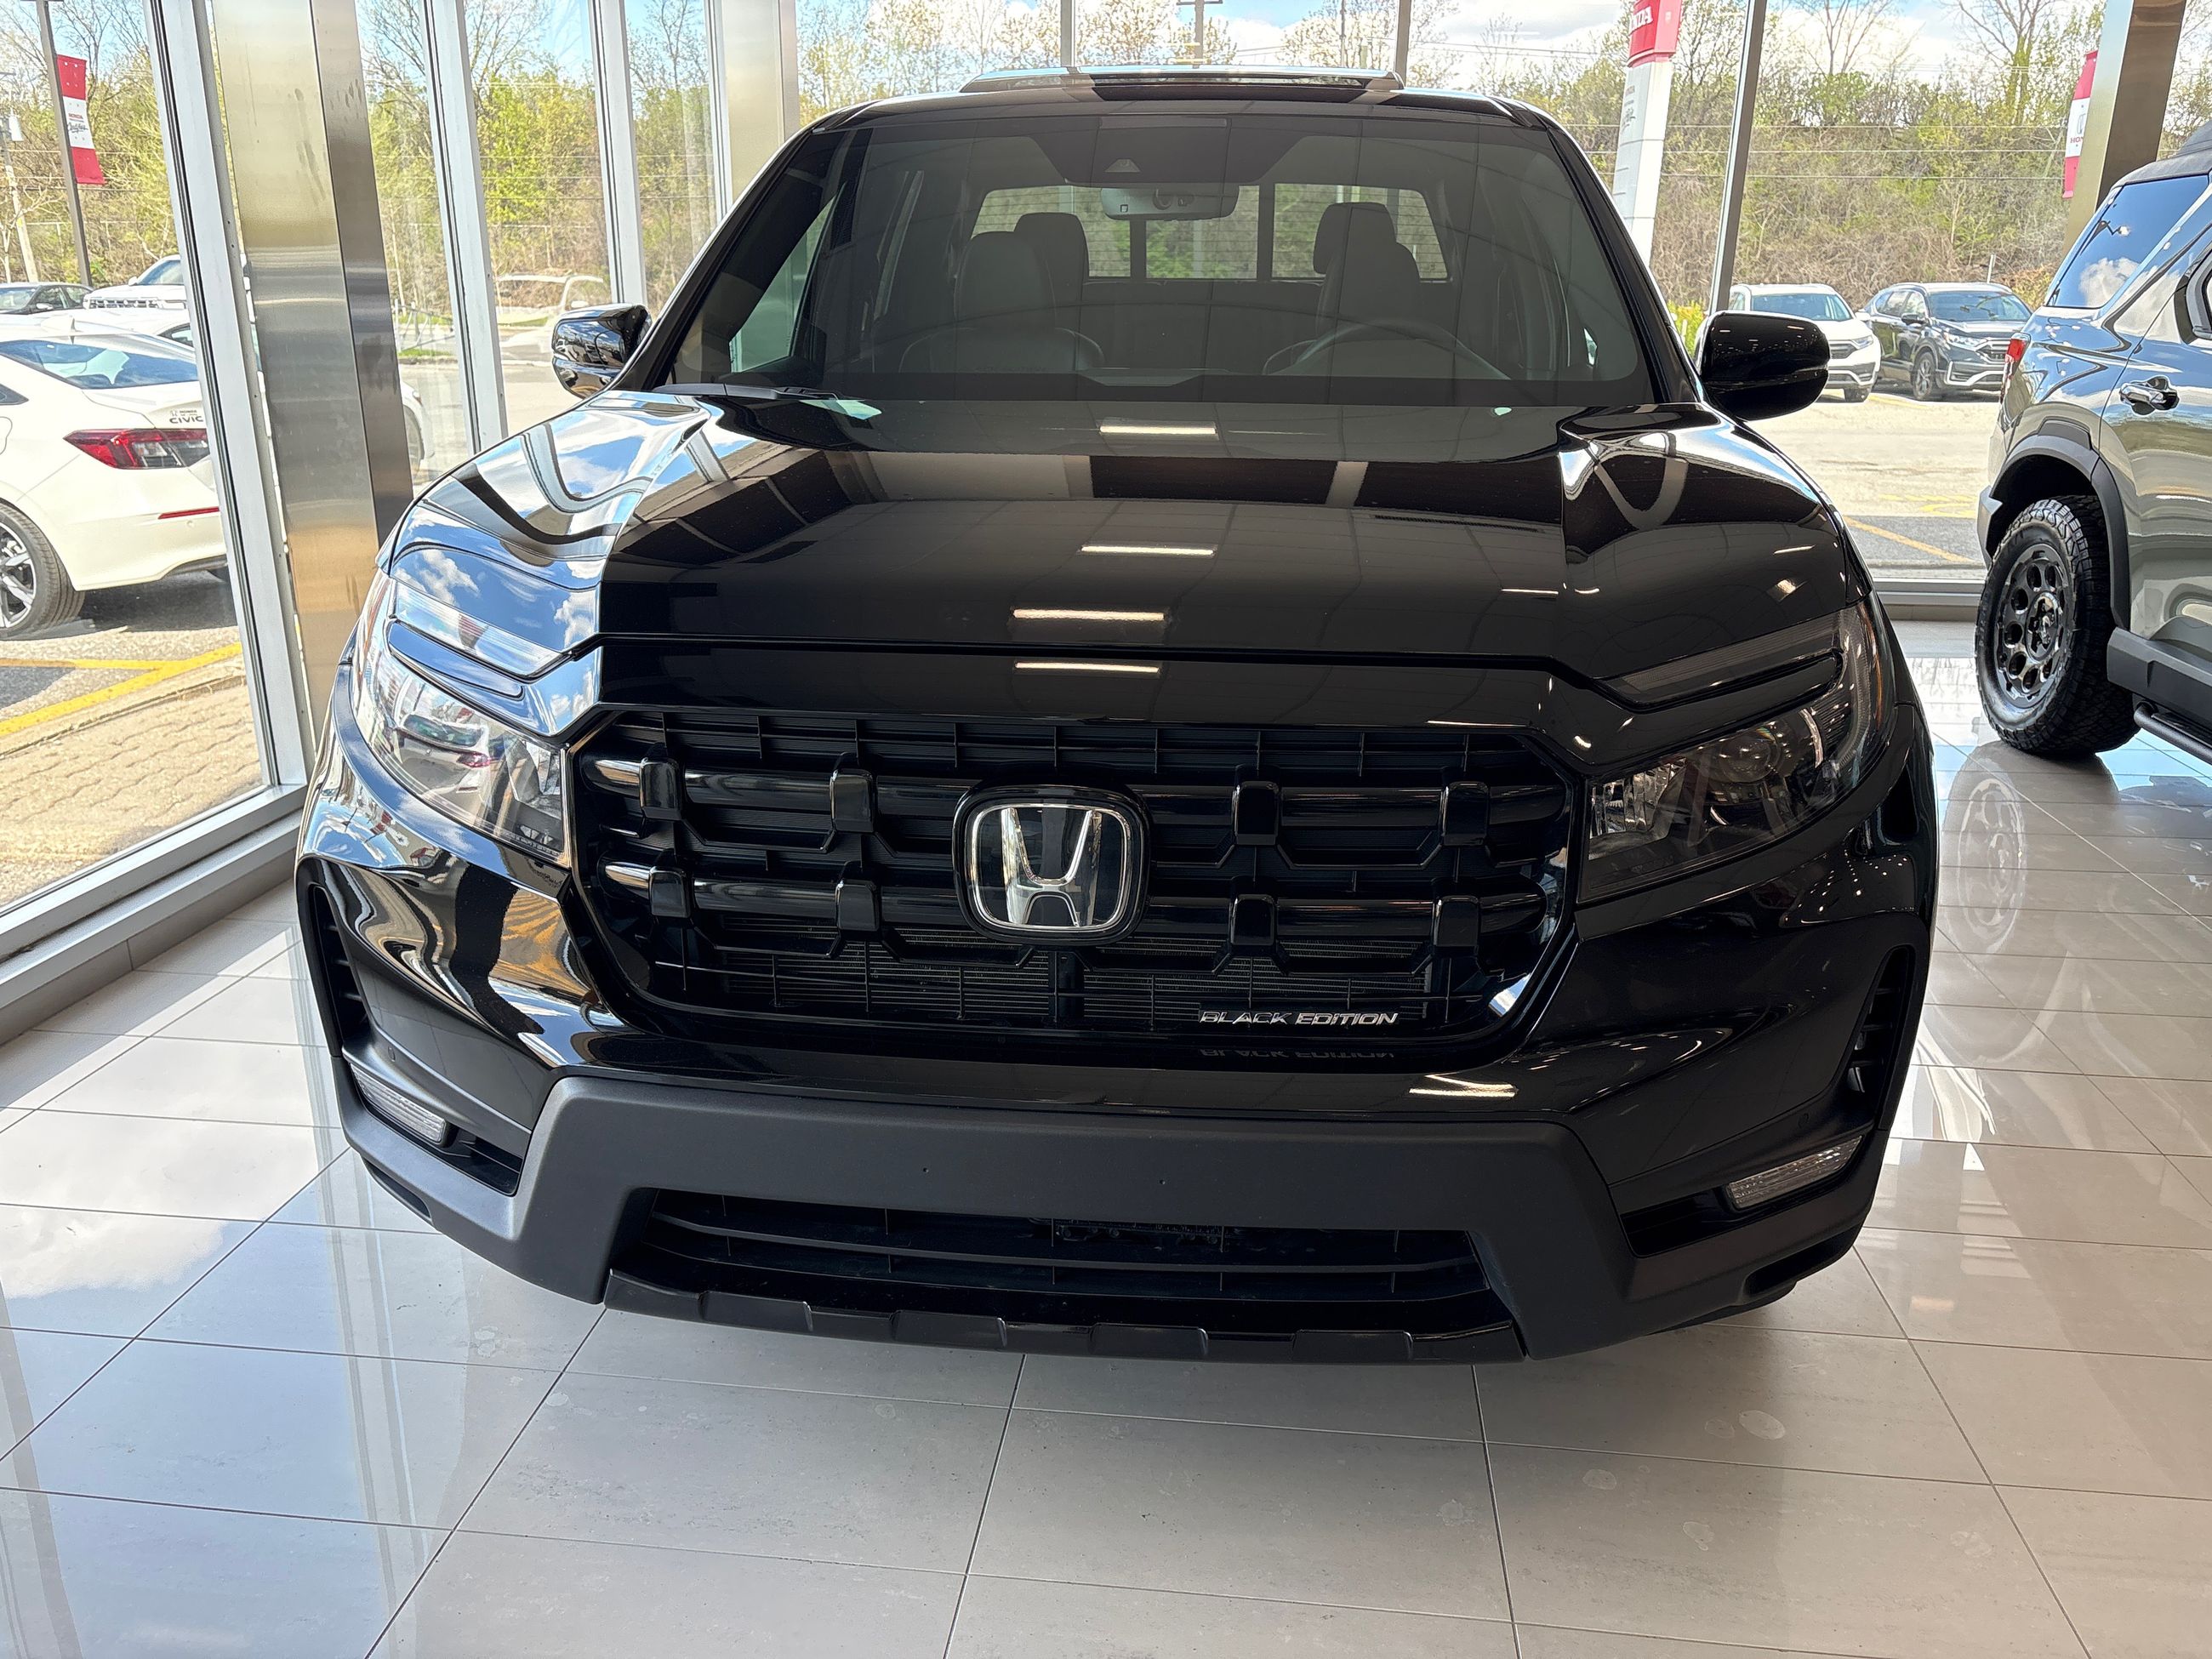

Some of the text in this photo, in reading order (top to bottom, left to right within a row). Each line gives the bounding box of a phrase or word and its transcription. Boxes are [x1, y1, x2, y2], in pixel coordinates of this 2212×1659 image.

[169, 415, 204, 424] CIVIC
[1199, 1011, 1399, 1026] BLACK EDITION
